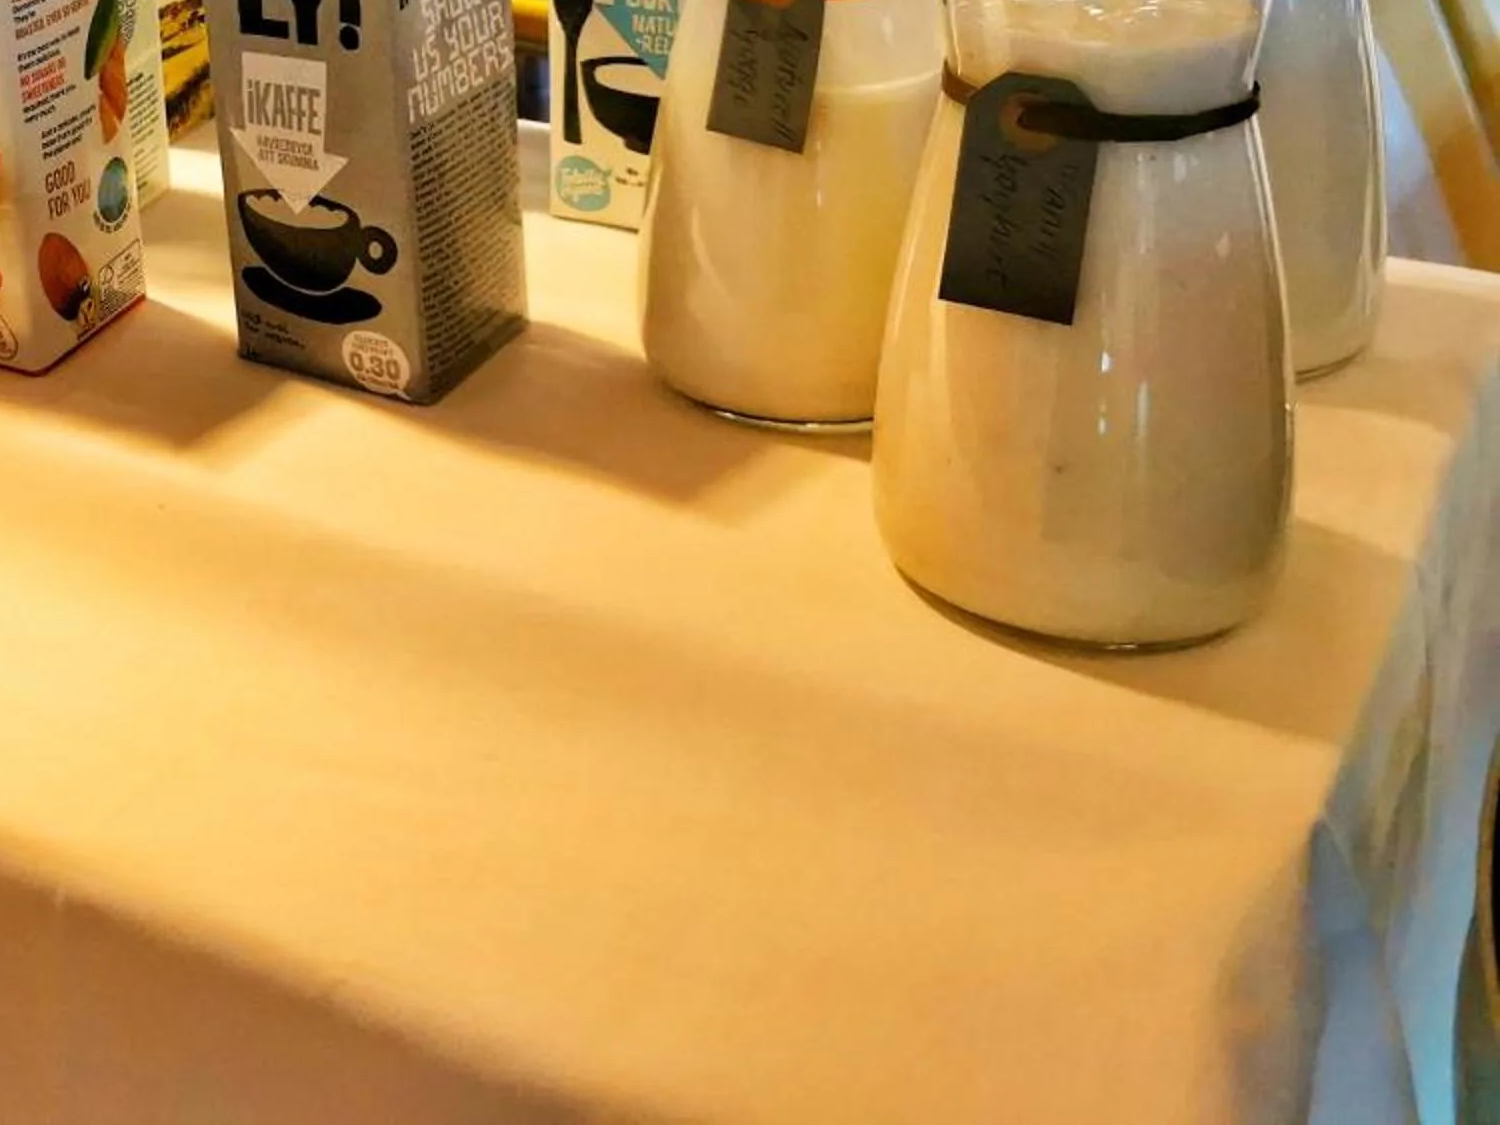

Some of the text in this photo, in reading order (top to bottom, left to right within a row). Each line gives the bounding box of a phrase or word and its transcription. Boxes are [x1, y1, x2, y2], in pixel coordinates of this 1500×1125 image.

[412, 0, 505, 83] US YOUR
[407, 39, 515, 125] NUMBERS
[45, 160, 76, 194] GOOD
[47, 177, 92, 221] FOR YOU
[349, 351, 401, 382] 0.30
